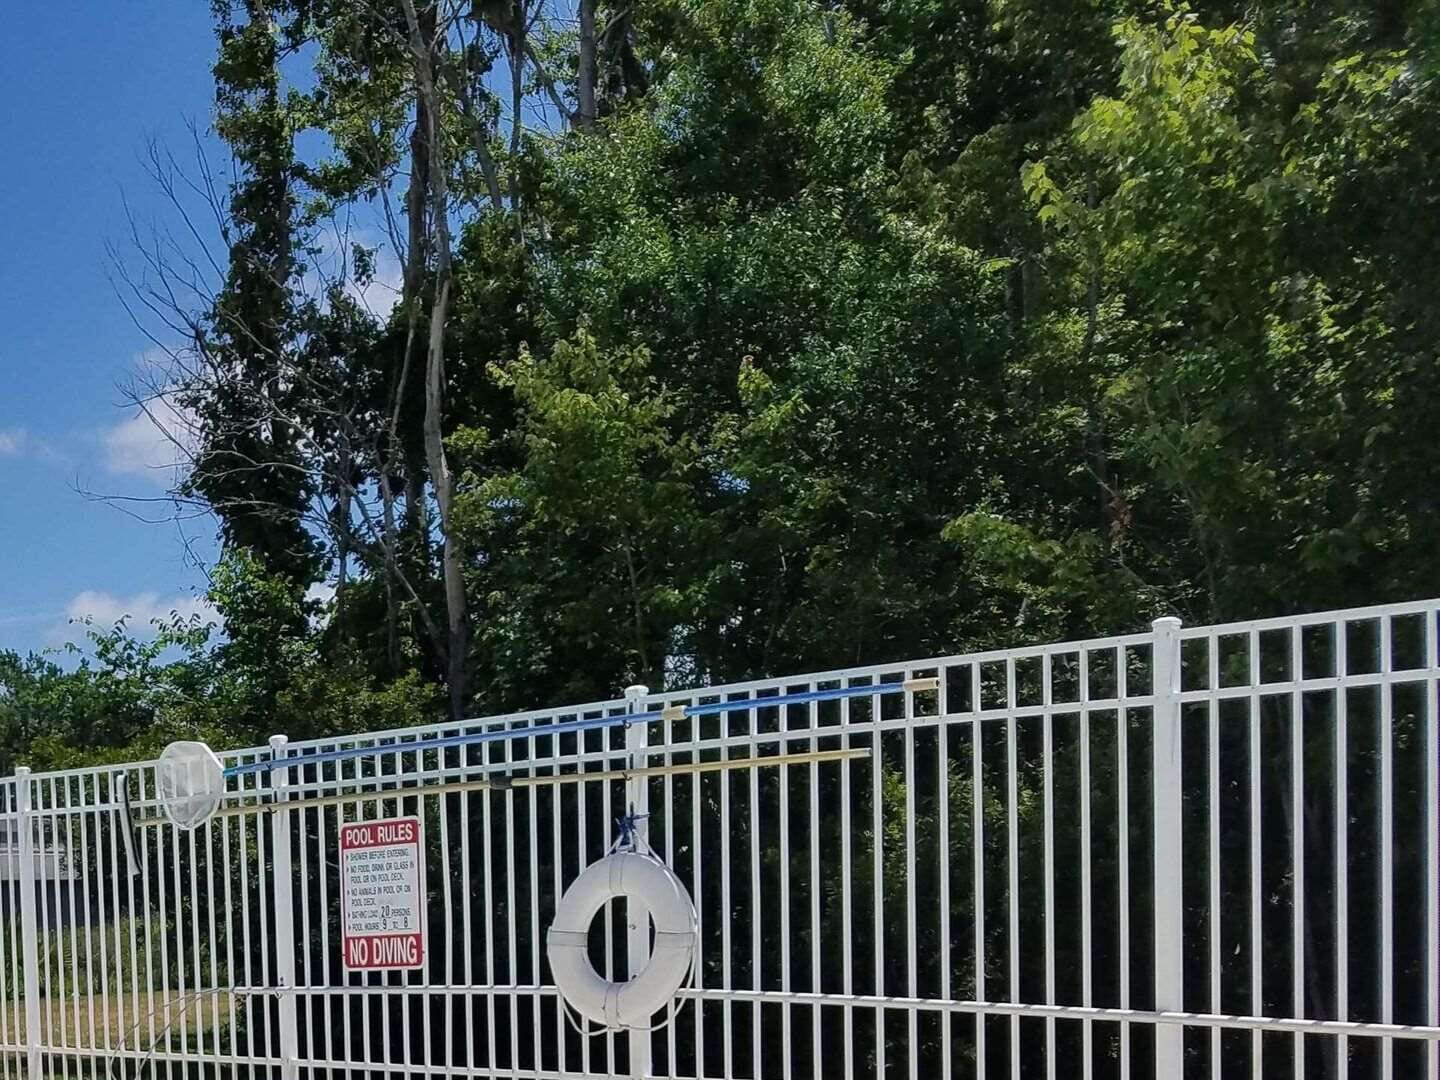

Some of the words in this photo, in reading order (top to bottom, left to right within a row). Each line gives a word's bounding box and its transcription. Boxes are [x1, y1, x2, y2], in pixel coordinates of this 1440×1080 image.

[346, 828, 374, 846] POOL
[378, 823, 413, 842] RULES
[403, 917, 408, 928] 8
[350, 939, 368, 965] NO
[372, 935, 417, 964] DIVING
